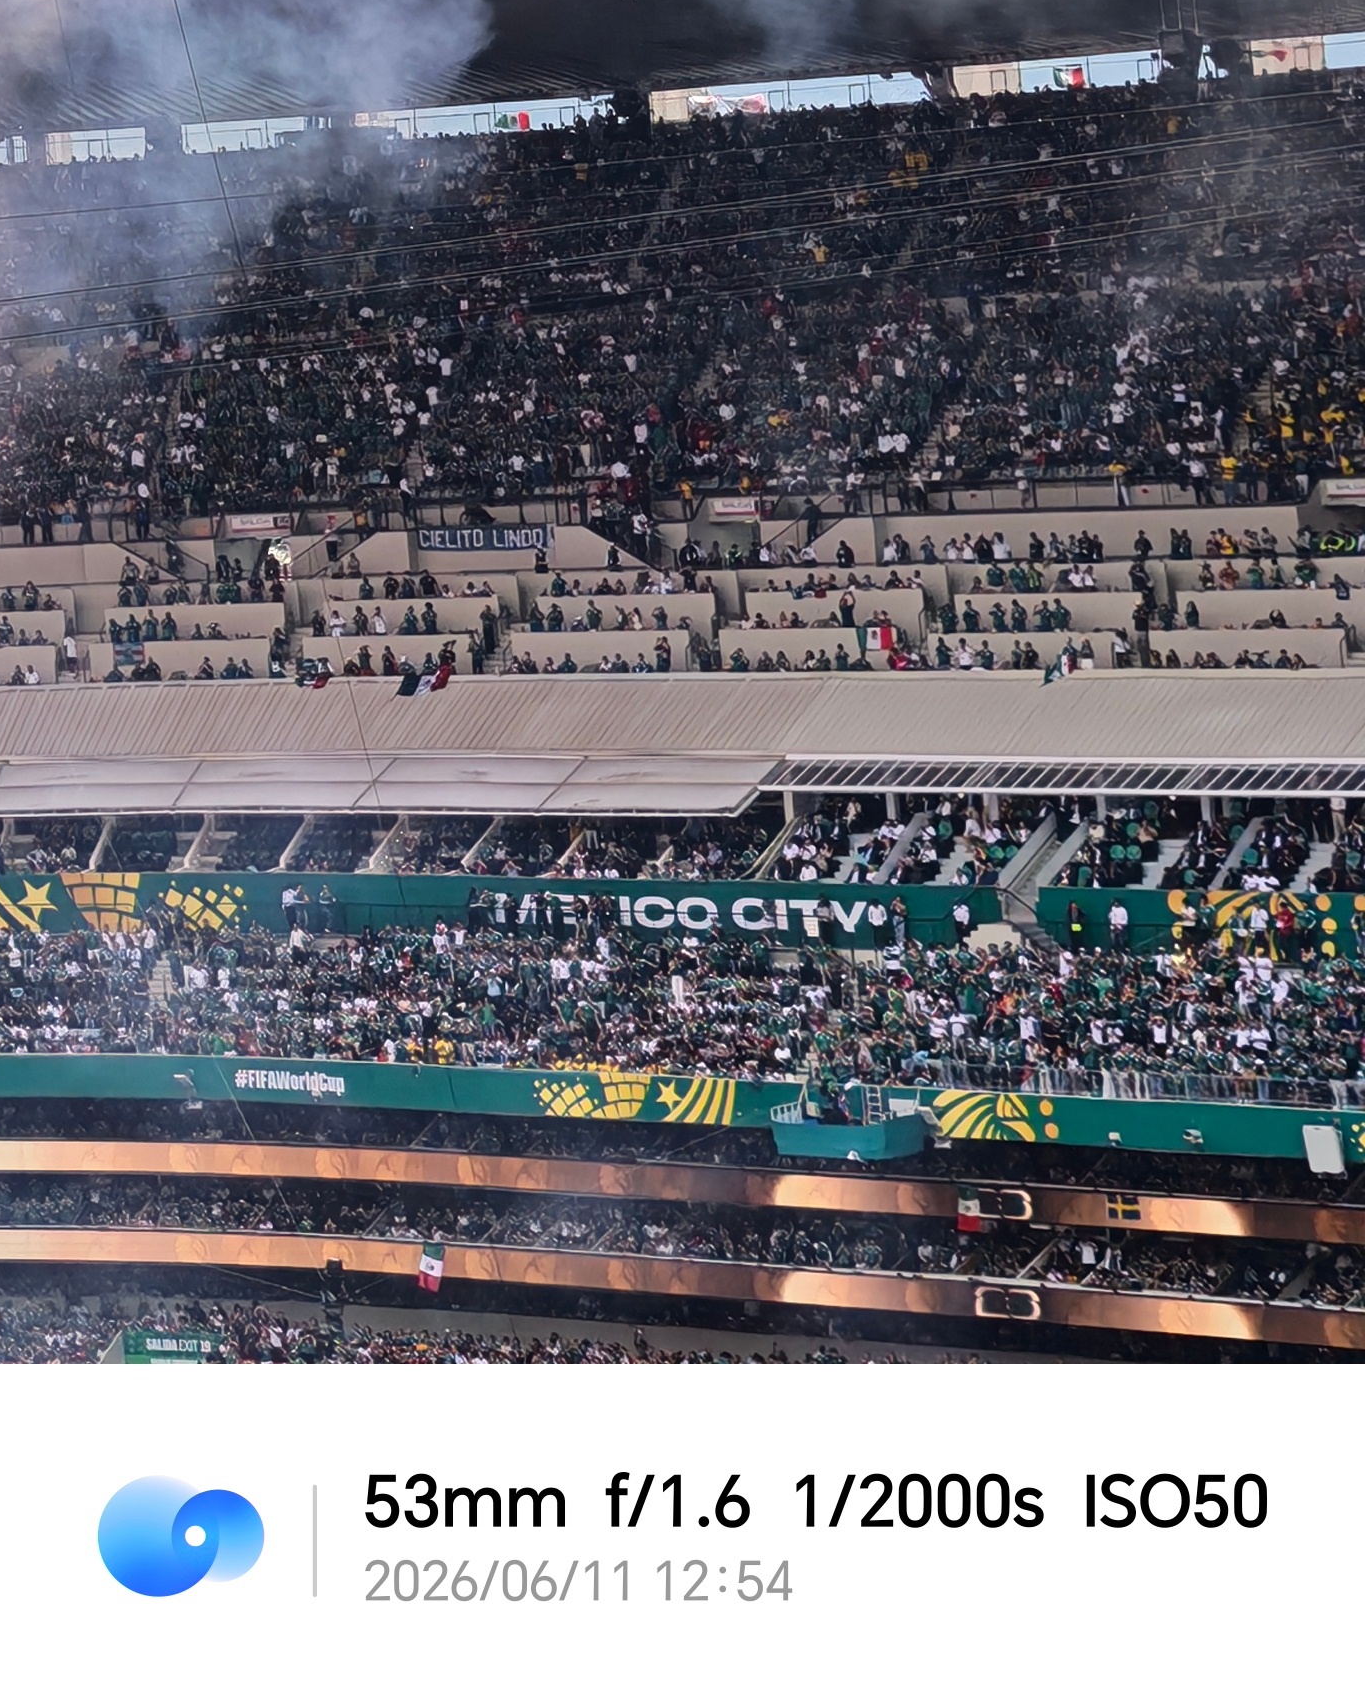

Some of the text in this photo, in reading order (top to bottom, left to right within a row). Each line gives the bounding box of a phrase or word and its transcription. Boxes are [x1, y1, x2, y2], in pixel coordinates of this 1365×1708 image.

[419, 528, 544, 549] CIELITO LINDO
[731, 897, 867, 937] CITY
[235, 1069, 345, 1096] #FIFAWorldCup
